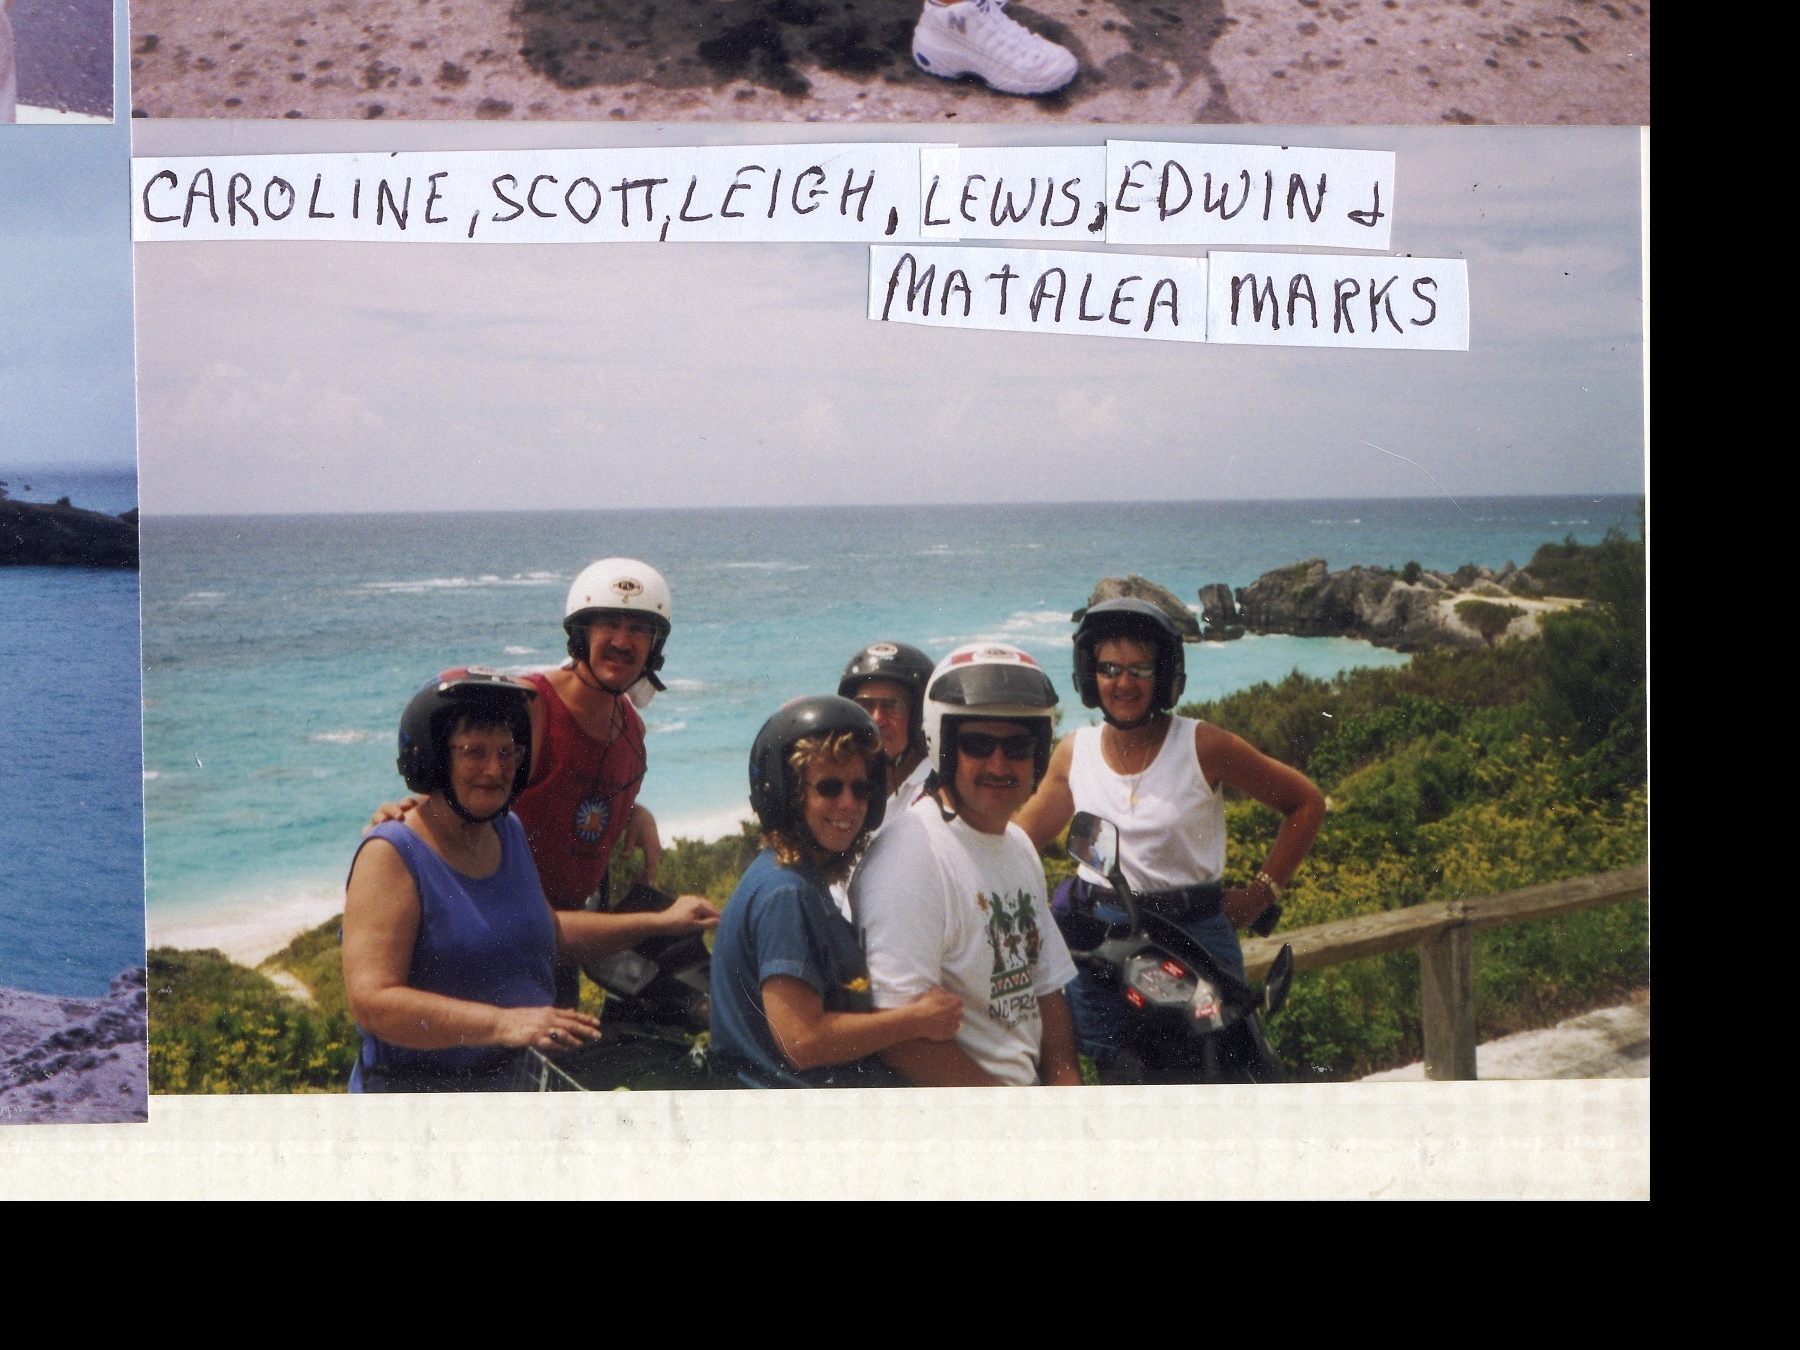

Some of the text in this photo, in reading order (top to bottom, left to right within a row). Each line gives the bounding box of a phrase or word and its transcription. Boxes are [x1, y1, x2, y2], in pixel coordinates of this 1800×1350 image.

[142, 168, 479, 239] CAROLINE,
[492, 173, 670, 242] SCOTT,
[679, 165, 899, 236] LEIGH,
[923, 177, 1108, 233] LEWIS,
[1115, 159, 1327, 223] EDWIN
[884, 252, 1438, 334] MATALEA MARKS
